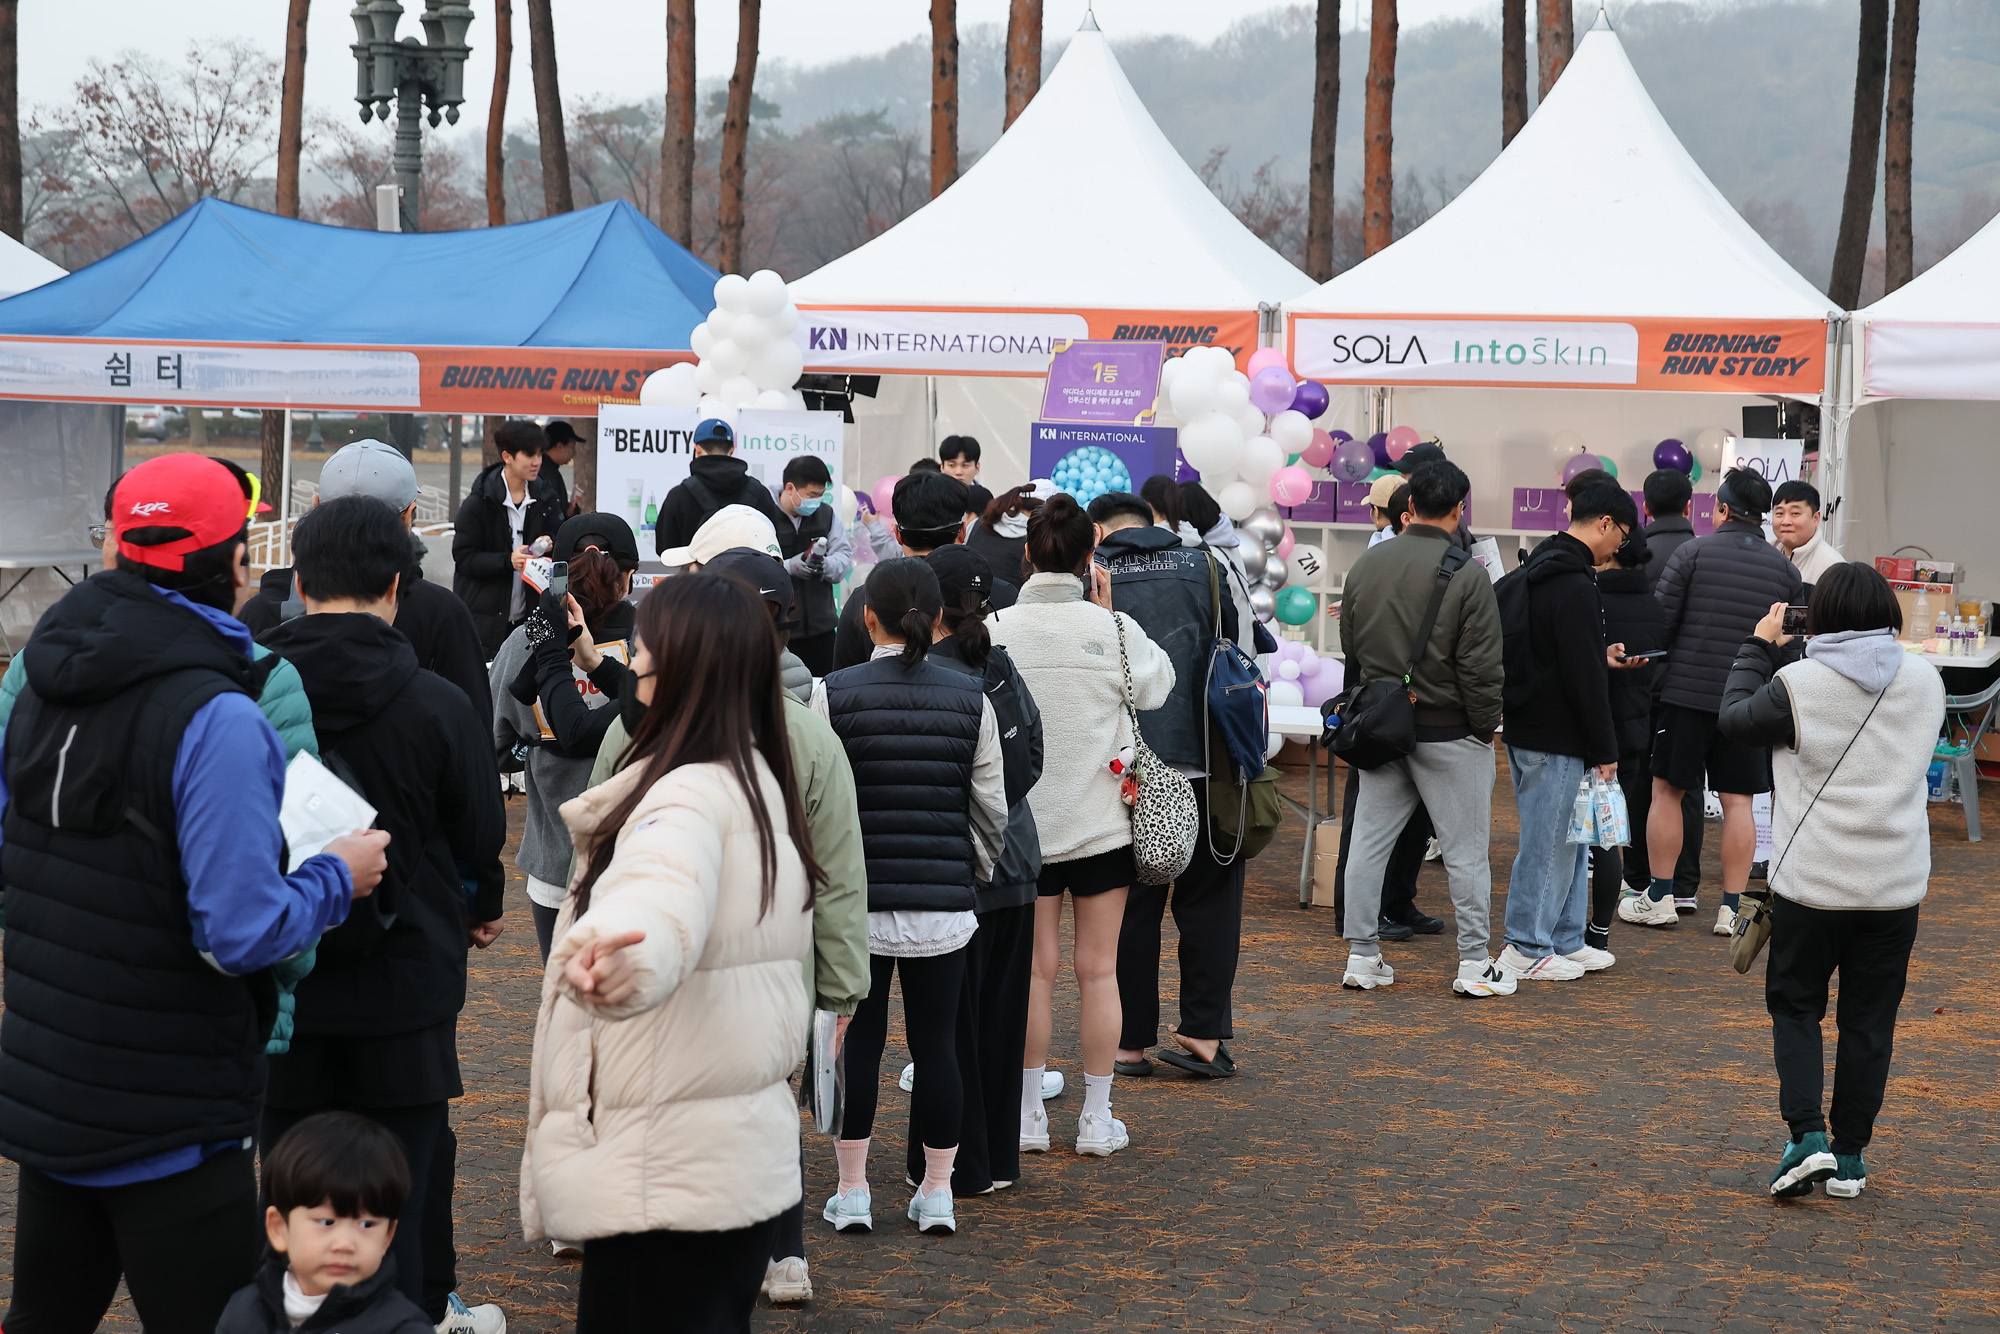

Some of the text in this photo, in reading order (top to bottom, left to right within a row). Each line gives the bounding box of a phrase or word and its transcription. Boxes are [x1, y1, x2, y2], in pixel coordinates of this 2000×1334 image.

[809, 327, 1054, 354] KN INTERNATIONAL
[1112, 325, 1218, 344] BURNING
[1663, 333, 1782, 354] BURNING
[104, 352, 182, 390] 쉼 터
[1092, 362, 1119, 383] 1등
[1660, 356, 1811, 377] RUN STORY
[440, 365, 557, 390] BURNING
[561, 368, 620, 392] RUN
[563, 394, 600, 405] Casual
[604, 428, 694, 455] ZM BEAUTY
[1039, 428, 1146, 443] KN INTERNATIONAL
[1297, 552, 1320, 577] ZM
